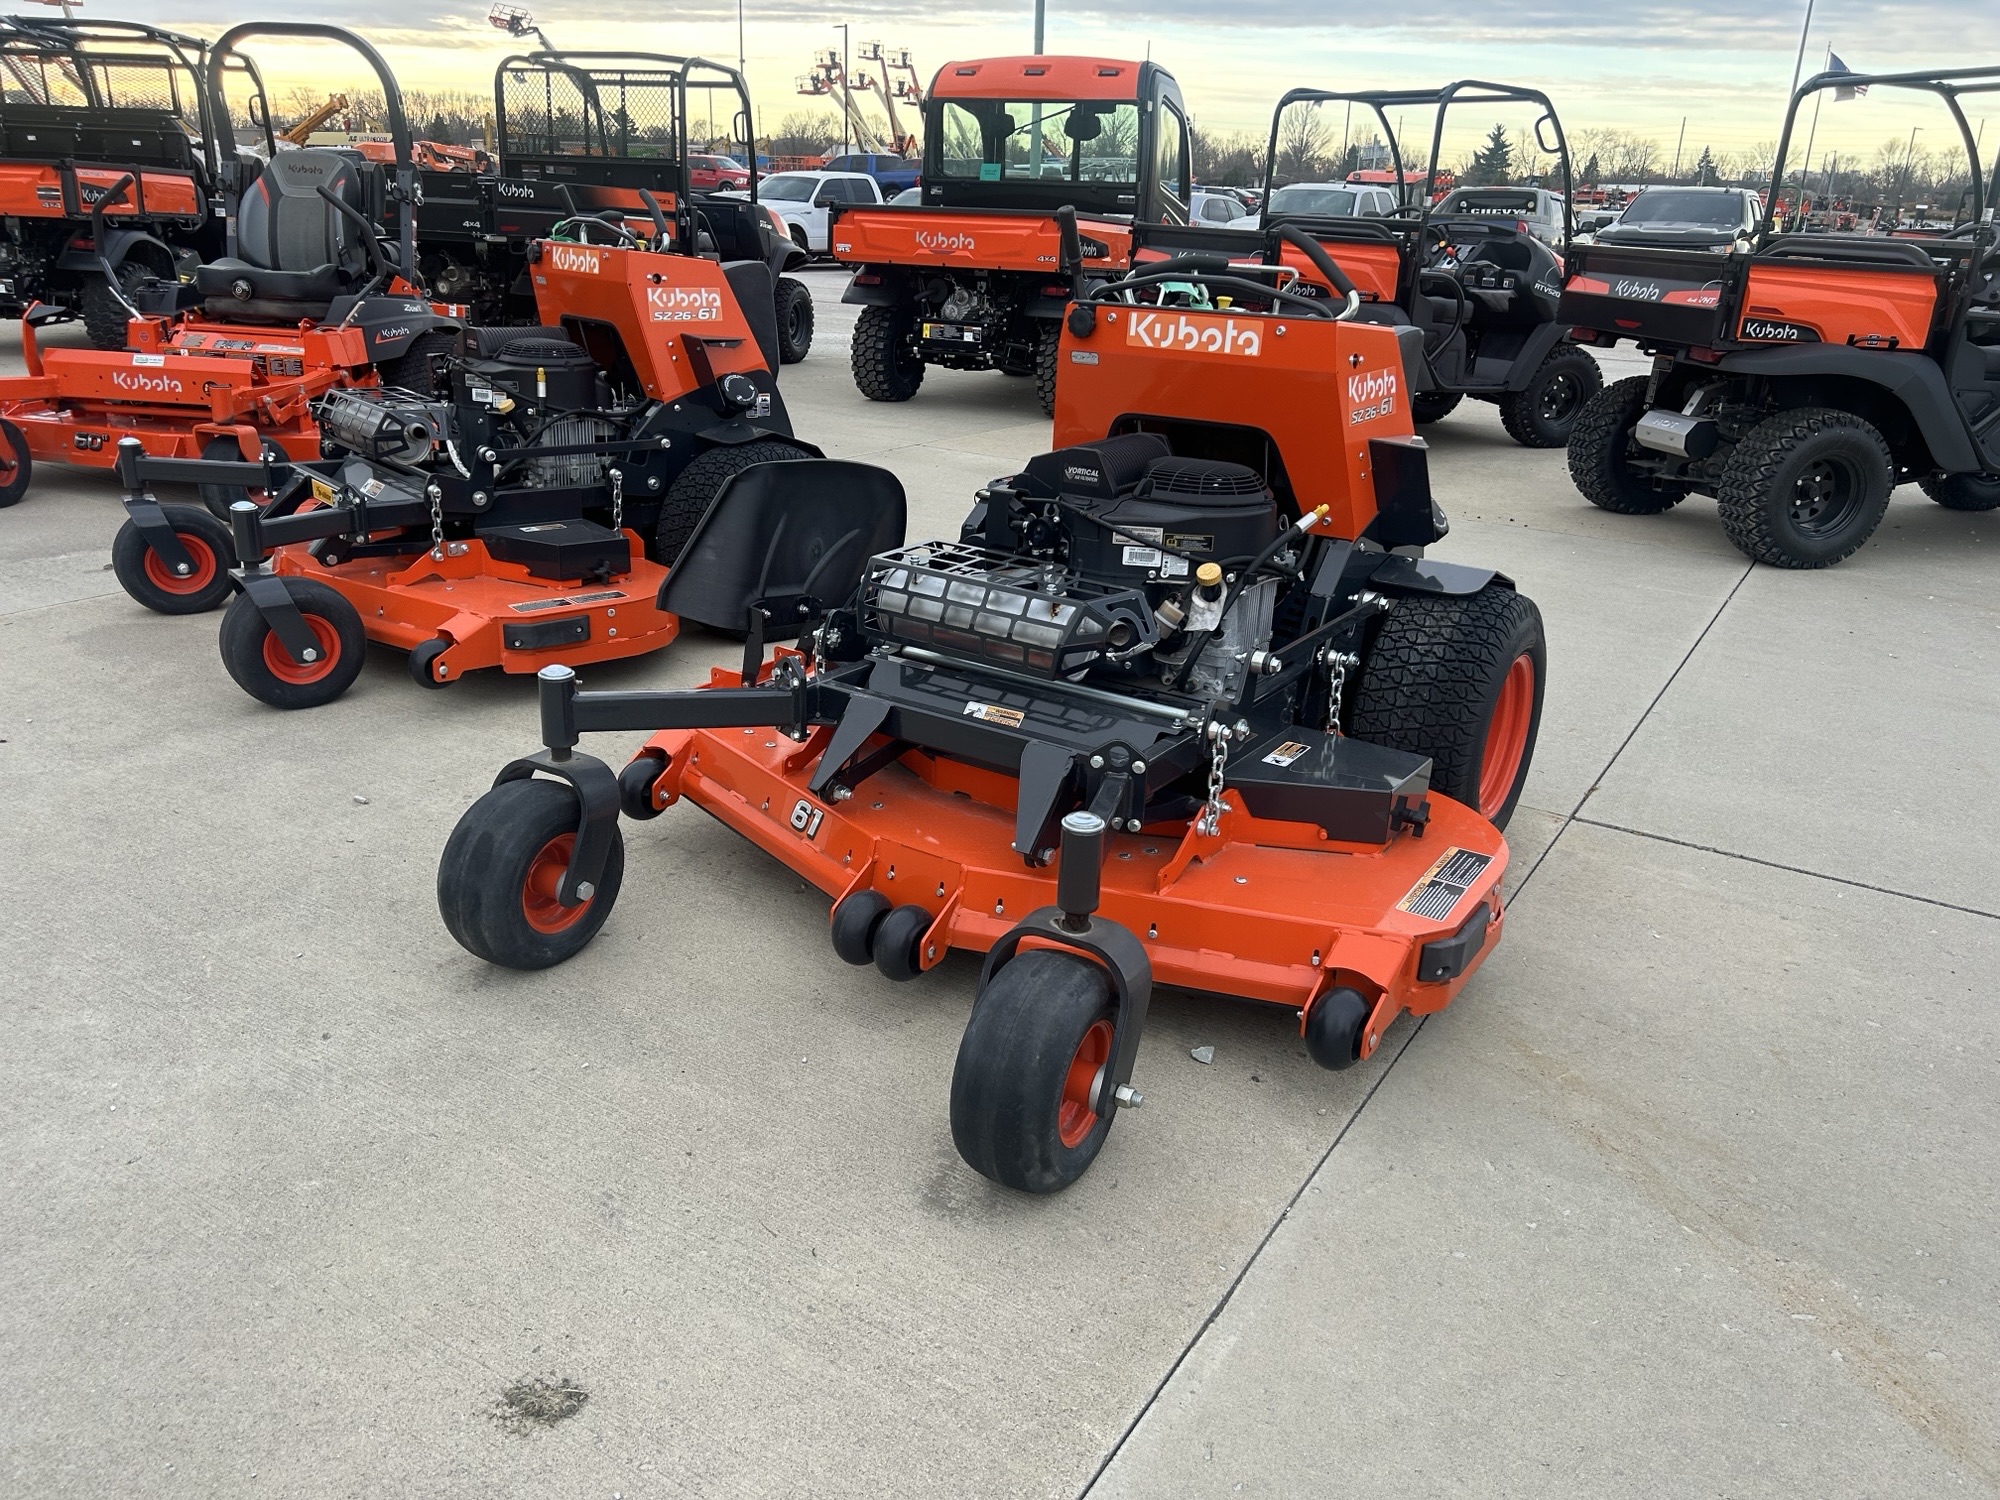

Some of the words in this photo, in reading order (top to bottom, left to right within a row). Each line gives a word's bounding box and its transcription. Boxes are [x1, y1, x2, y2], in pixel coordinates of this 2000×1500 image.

[288, 164, 323, 175] Kubota
[498, 183, 535, 199] Kubota
[462, 220, 481, 229] 4x4
[916, 231, 975, 250] Kubota
[553, 246, 599, 274] Kubota
[1036, 255, 1057, 263] 4x4
[647, 287, 721, 308] Kubota
[1534, 282, 1562, 298] RTV520
[1615, 280, 1660, 301] Kubota
[381, 326, 410, 338] Kubota
[1129, 312, 1260, 356] Kubota
[1745, 322, 1798, 340] Kubota
[112, 372, 183, 393] Kubota
[1348, 369, 1396, 403] Kubota
[1653, 420, 1679, 429] HOT
[1068, 466, 1099, 477] VORTICAL
[790, 799, 824, 840] 61
